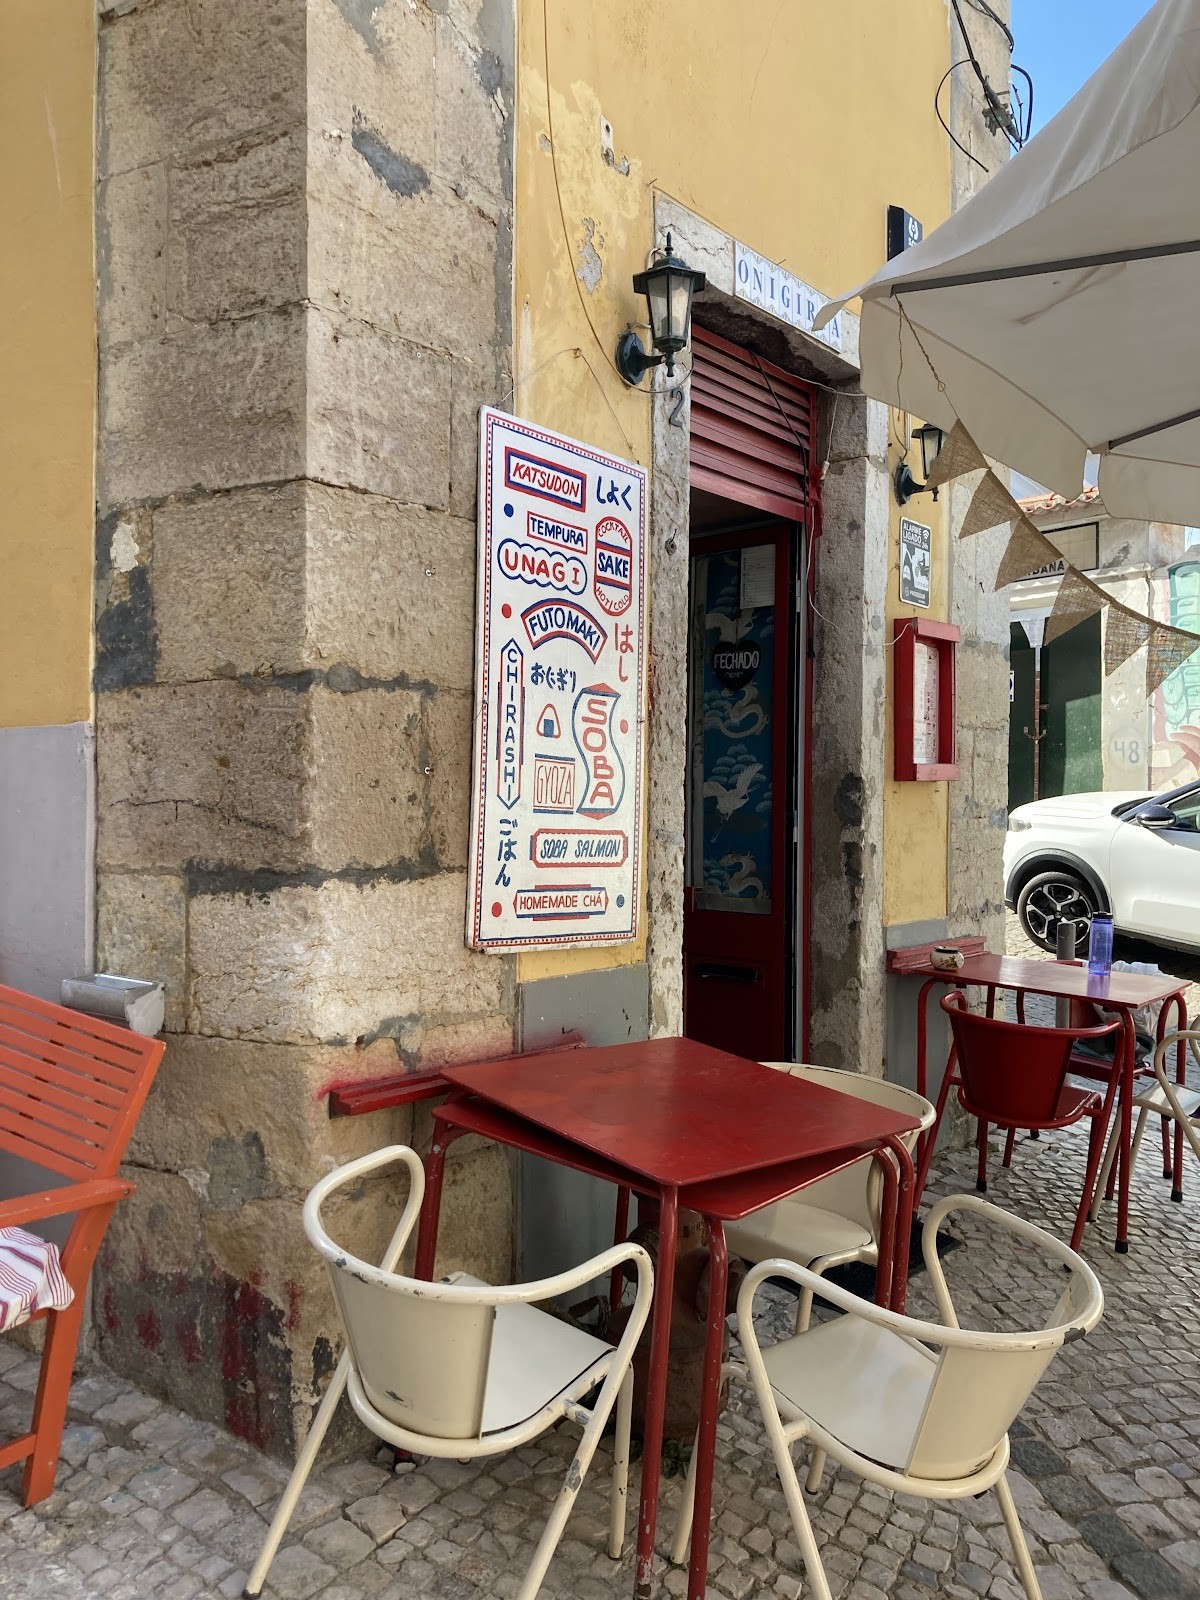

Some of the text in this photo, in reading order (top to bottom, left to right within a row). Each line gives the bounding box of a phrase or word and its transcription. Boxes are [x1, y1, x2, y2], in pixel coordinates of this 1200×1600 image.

[738, 259, 839, 339] ONIGIRA
[669, 388, 686, 428] 2
[512, 462, 580, 498] KATSUDON
[597, 475, 632, 512] しょく
[530, 517, 585, 548] TEMPURA
[598, 521, 629, 543] COCKTAIL
[903, 529, 922, 544] LIGADO
[504, 548, 580, 585] UNAGI
[598, 551, 629, 579] SAKE
[528, 607, 601, 651] FUTOMAKI
[614, 622, 635, 683] はし
[713, 651, 760, 670] FECHADO
[530, 661, 577, 693] おにぎり
[504, 648, 519, 802] CHIRASHI
[581, 698, 615, 806] SOBA
[1114, 740, 1140, 764] 48
[537, 764, 573, 805] GYOZA
[494, 818, 518, 887] ごはん
[540, 838, 621, 859] SOBA SALMON
[519, 891, 603, 910] HOMEMADE CHÁ
